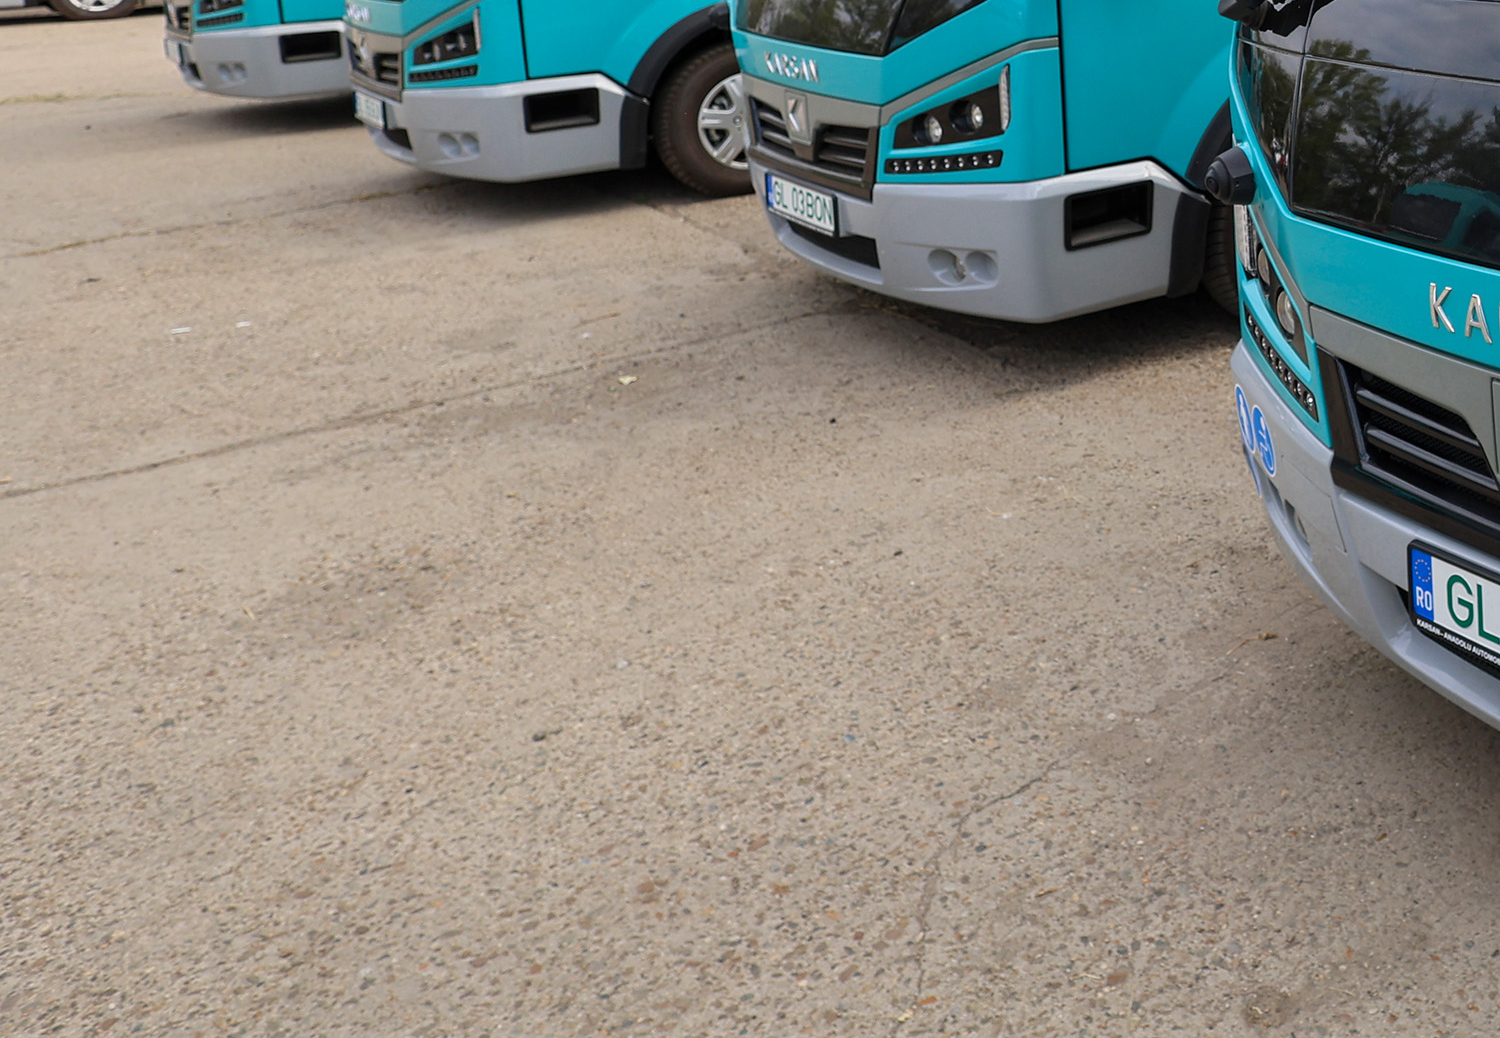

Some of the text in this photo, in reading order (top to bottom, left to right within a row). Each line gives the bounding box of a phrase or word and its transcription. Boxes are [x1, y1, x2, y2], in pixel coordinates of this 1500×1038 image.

[774, 181, 788, 209] GL
[1415, 586, 1433, 612] RO
[1446, 574, 1500, 646] GL
